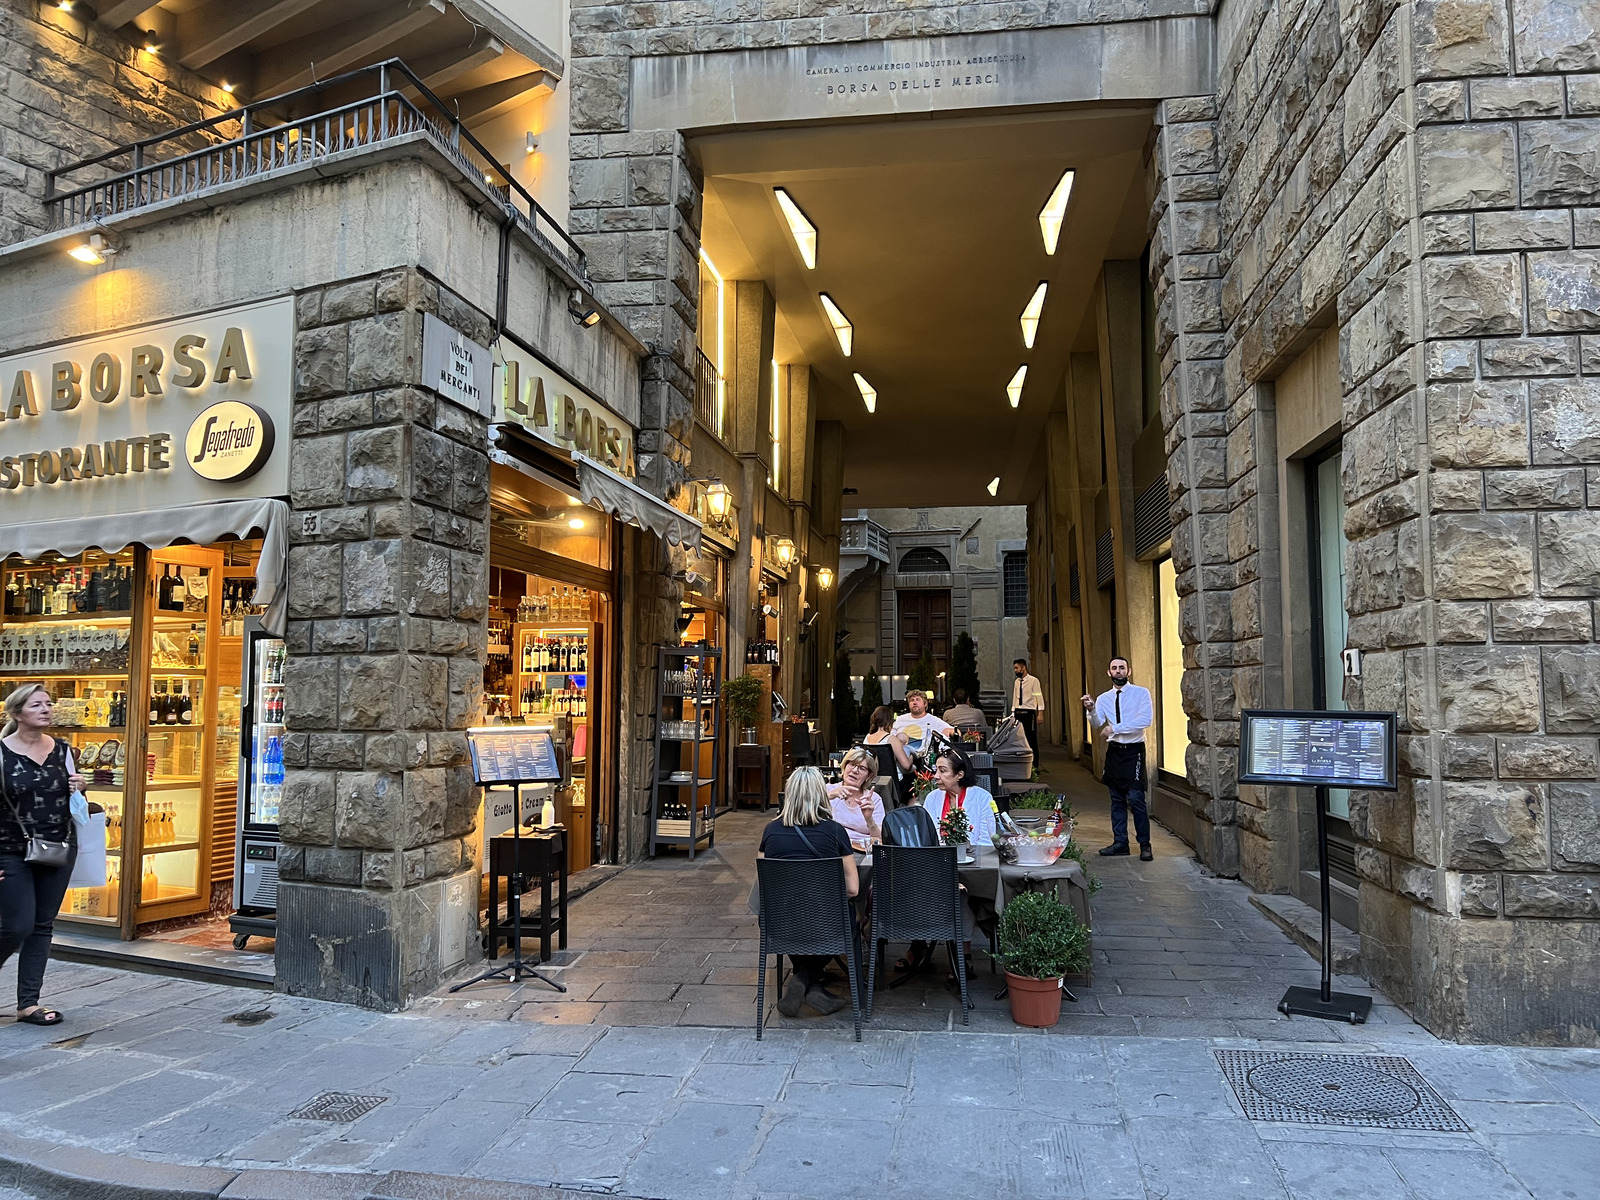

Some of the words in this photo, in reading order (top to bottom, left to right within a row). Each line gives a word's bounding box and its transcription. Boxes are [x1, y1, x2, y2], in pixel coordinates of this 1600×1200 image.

[806, 67, 840, 76] CAMERA
[857, 62, 911, 72] COMMERCIO
[915, 59, 961, 69] INDUSTRIA
[827, 82, 878, 95] BORSA
[889, 78, 941, 91] DELLE
[952, 73, 999, 87] MERCI
[450, 341, 473, 364] VOLTA
[0, 370, 38, 422] A
[51, 327, 251, 411] BORSA
[455, 360, 467, 377] DEI
[440, 369, 480, 400] MERCANTI
[505, 360, 548, 427] LA
[556, 394, 636, 478] BORSA
[193, 416, 255, 463] Segafredo
[220, 449, 243, 458] ZANETTI
[303, 515, 317, 532] 55
